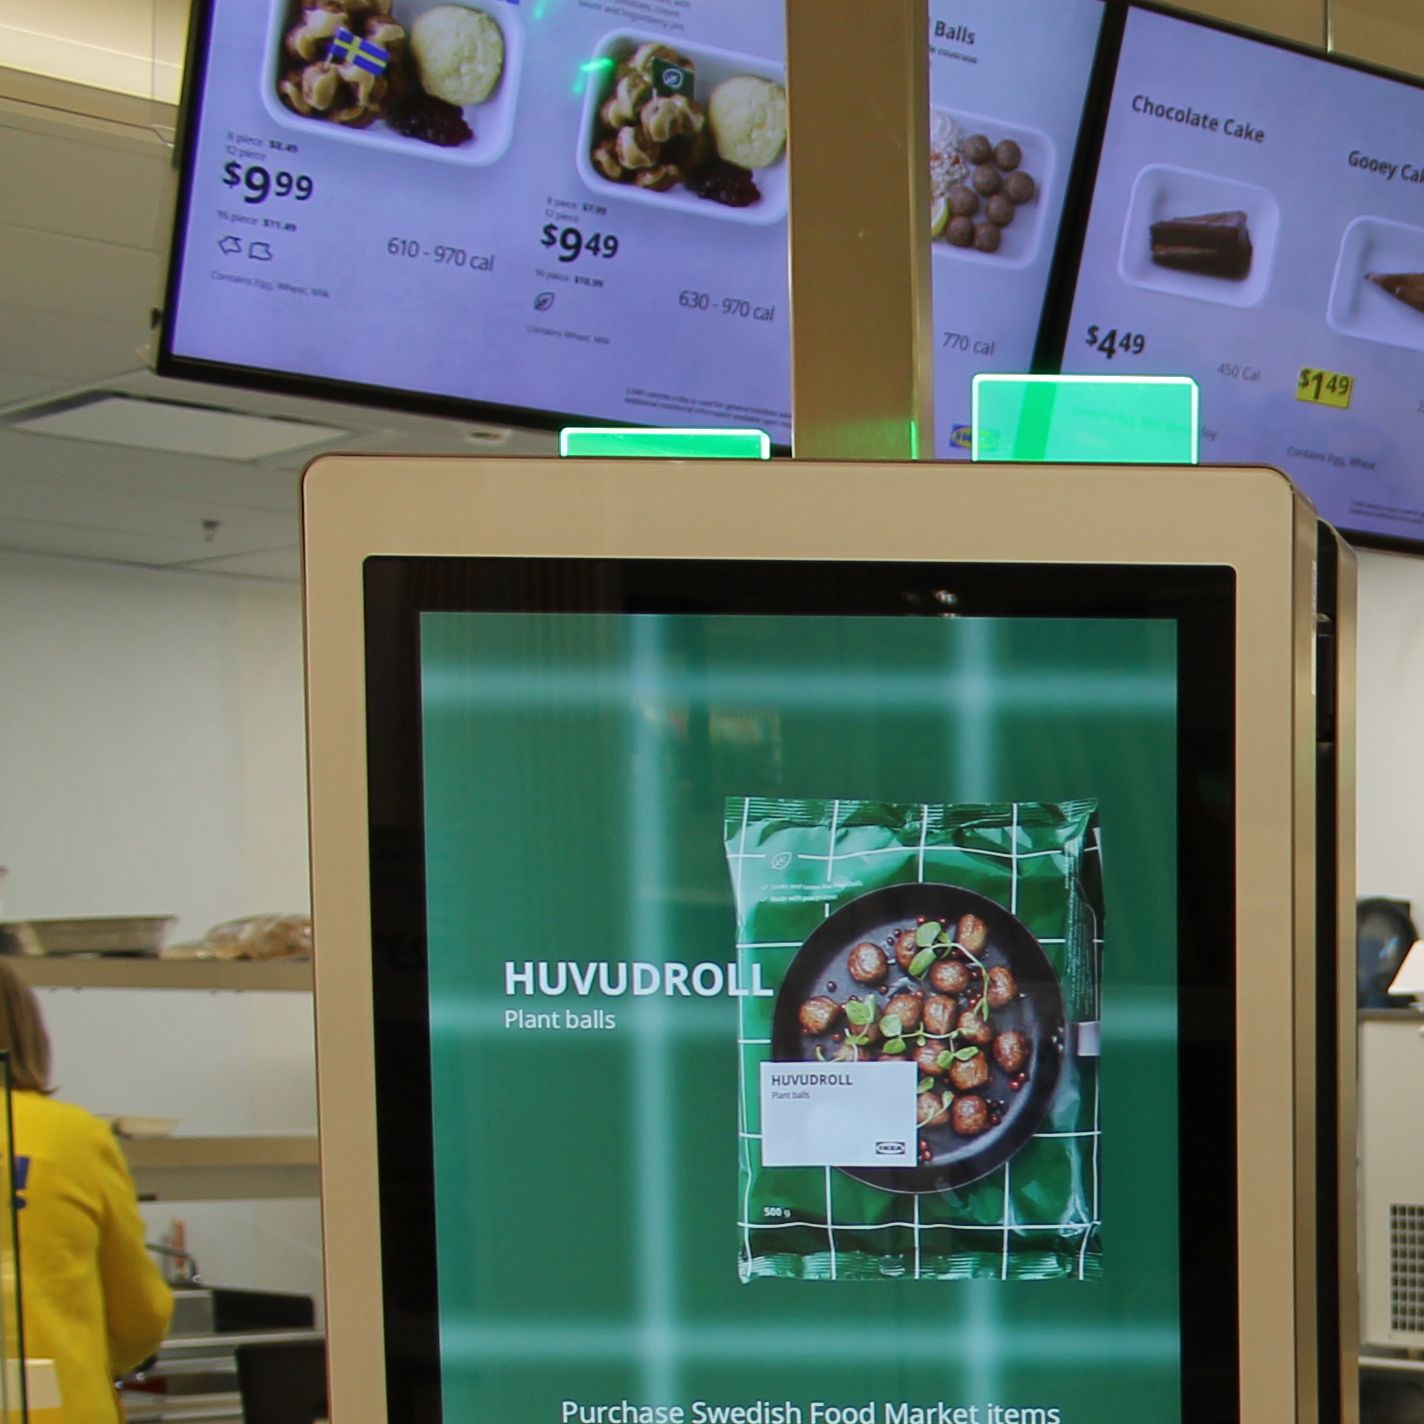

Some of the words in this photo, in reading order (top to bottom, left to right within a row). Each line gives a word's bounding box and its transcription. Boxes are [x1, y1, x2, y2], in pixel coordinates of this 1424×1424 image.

[935, 20, 976, 45] Balls
[1131, 94, 1219, 133] Chocolate
[1222, 118, 1265, 145] Cake
[1347, 149, 1398, 181] Gooey
[387, 237, 419, 258] 610
[434, 244, 466, 267] 970
[469, 254, 495, 272] cal
[679, 290, 709, 310] 630
[722, 298, 749, 317] 970
[753, 306, 775, 321] cal
[943, 332, 969, 351] 770
[973, 339, 995, 356] cal
[1217, 362, 1240, 379] 450
[1242, 366, 1262, 382] Cal
[504, 961, 775, 997] HUVUDROLL
[504, 1009, 560, 1029] Plant
[566, 1009, 616, 1029] balls
[771, 1074, 853, 1086] HUVUDROLL
[771, 1091, 791, 1099] Plant
[792, 1091, 810, 1099] balls
[764, 1207, 781, 1217] 500
[783, 1208, 791, 1218] g
[562, 1400, 685, 1424] Purchase
[692, 1401, 801, 1424] Swedish
[810, 1401, 875, 1424] Food
